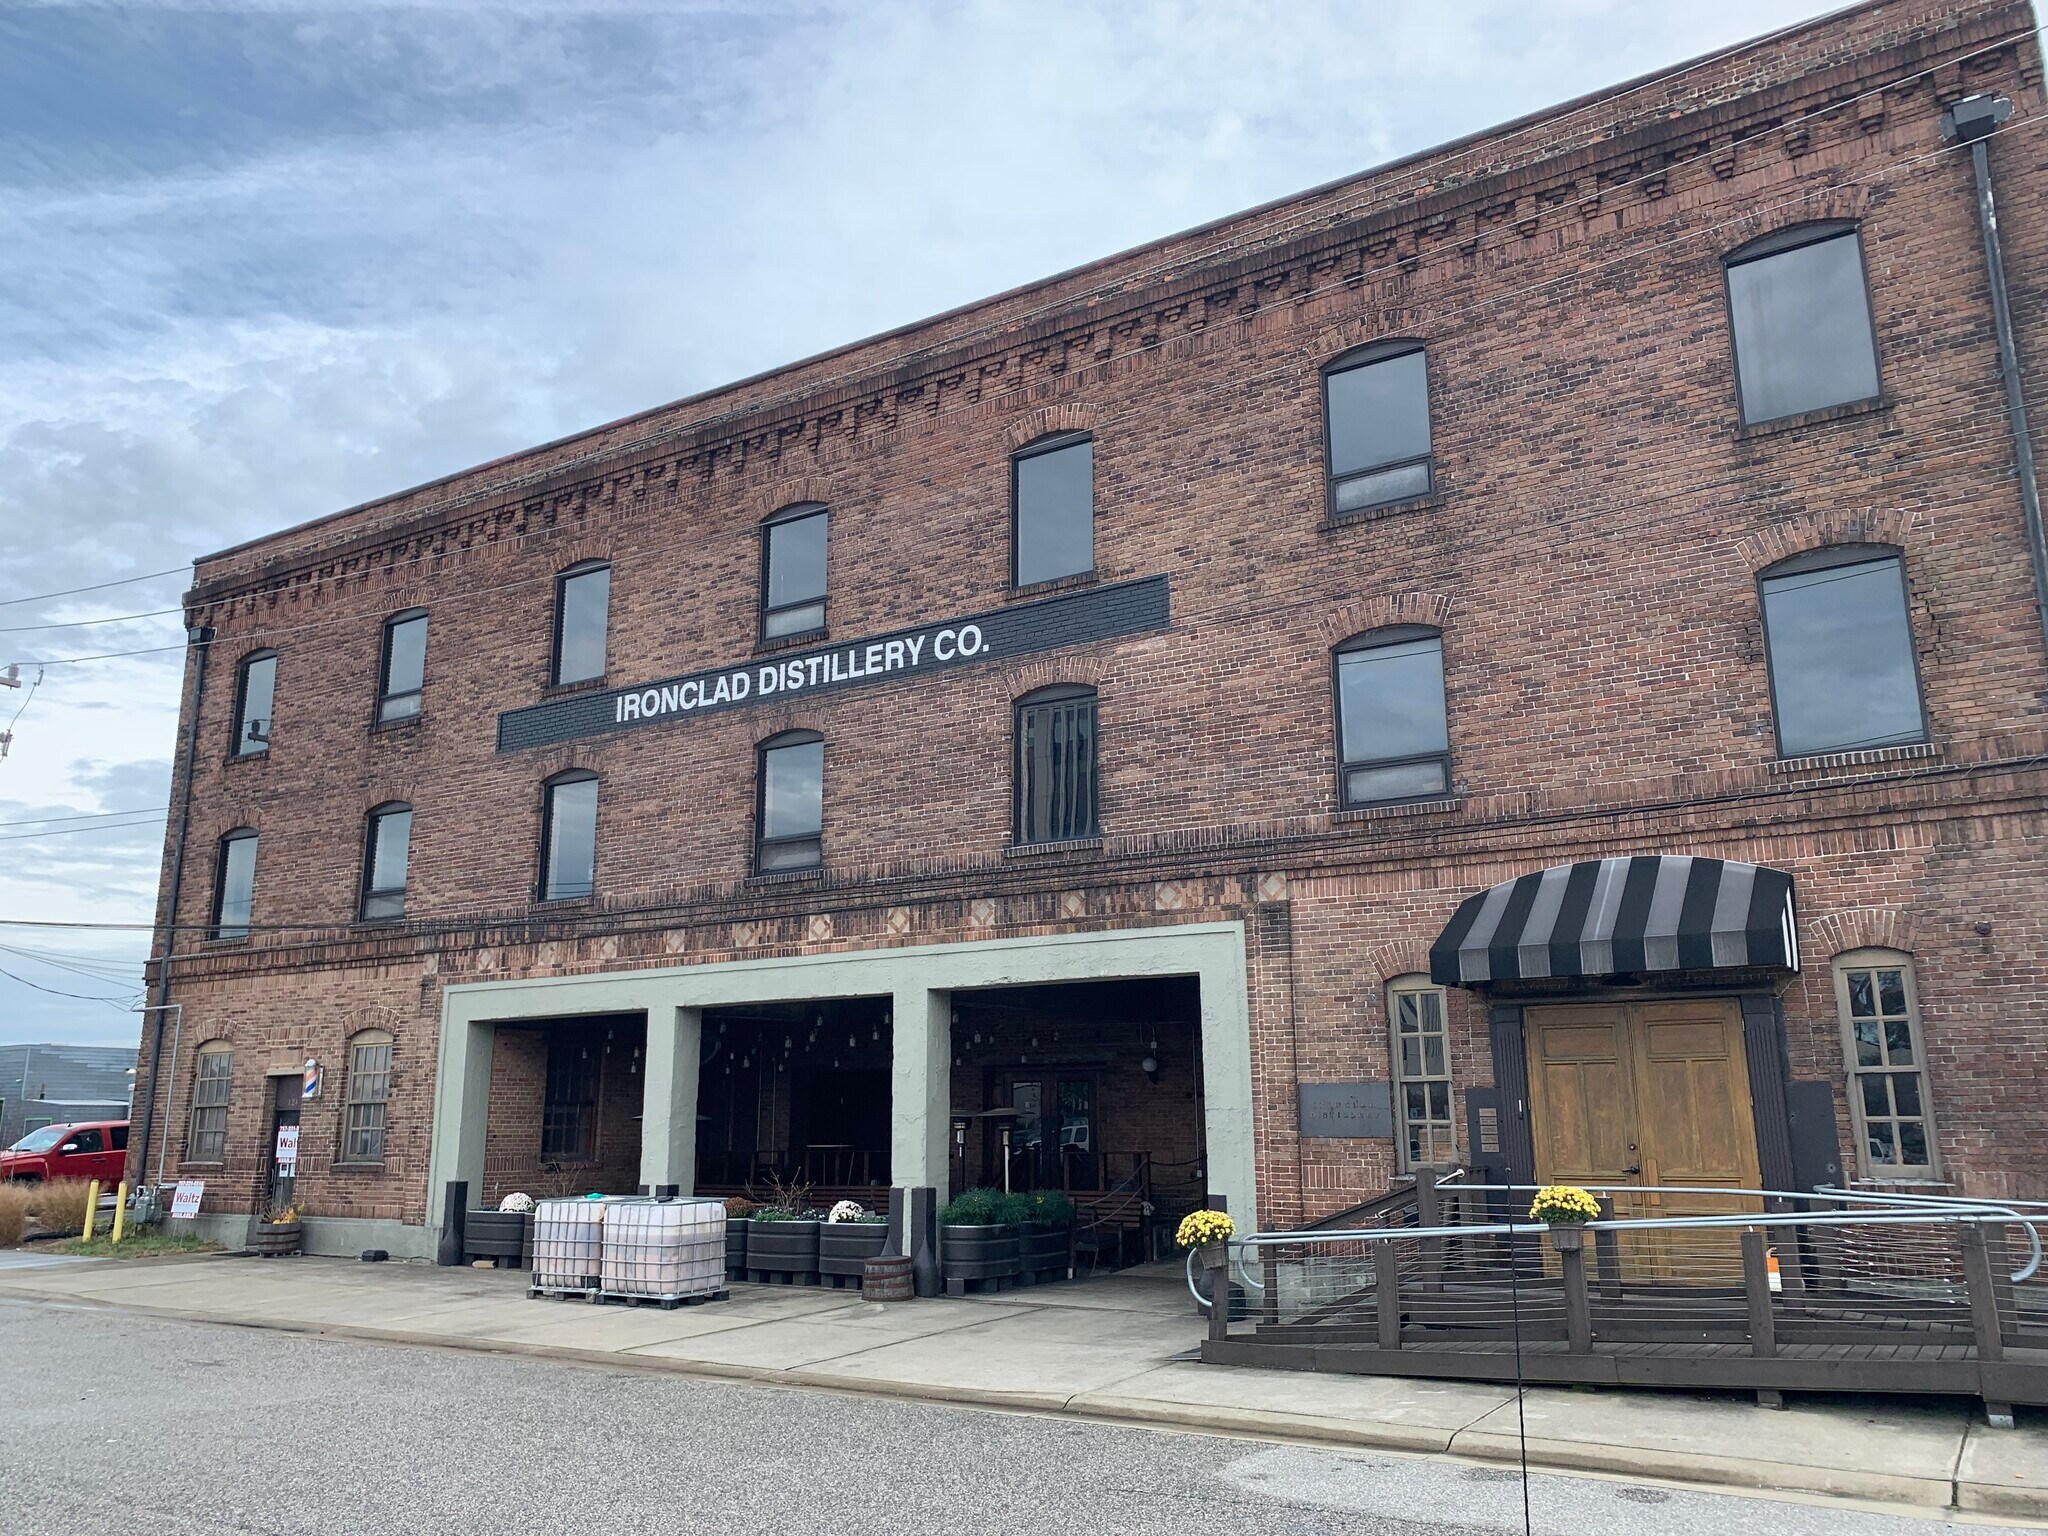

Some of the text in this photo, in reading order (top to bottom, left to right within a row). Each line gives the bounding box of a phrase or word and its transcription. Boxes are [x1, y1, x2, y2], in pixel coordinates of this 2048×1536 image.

[616, 624, 990, 723] IRONCLAD DISTILLERY CO.
[280, 1137, 297, 1148] Wal
[176, 1192, 200, 1203] Waltz
